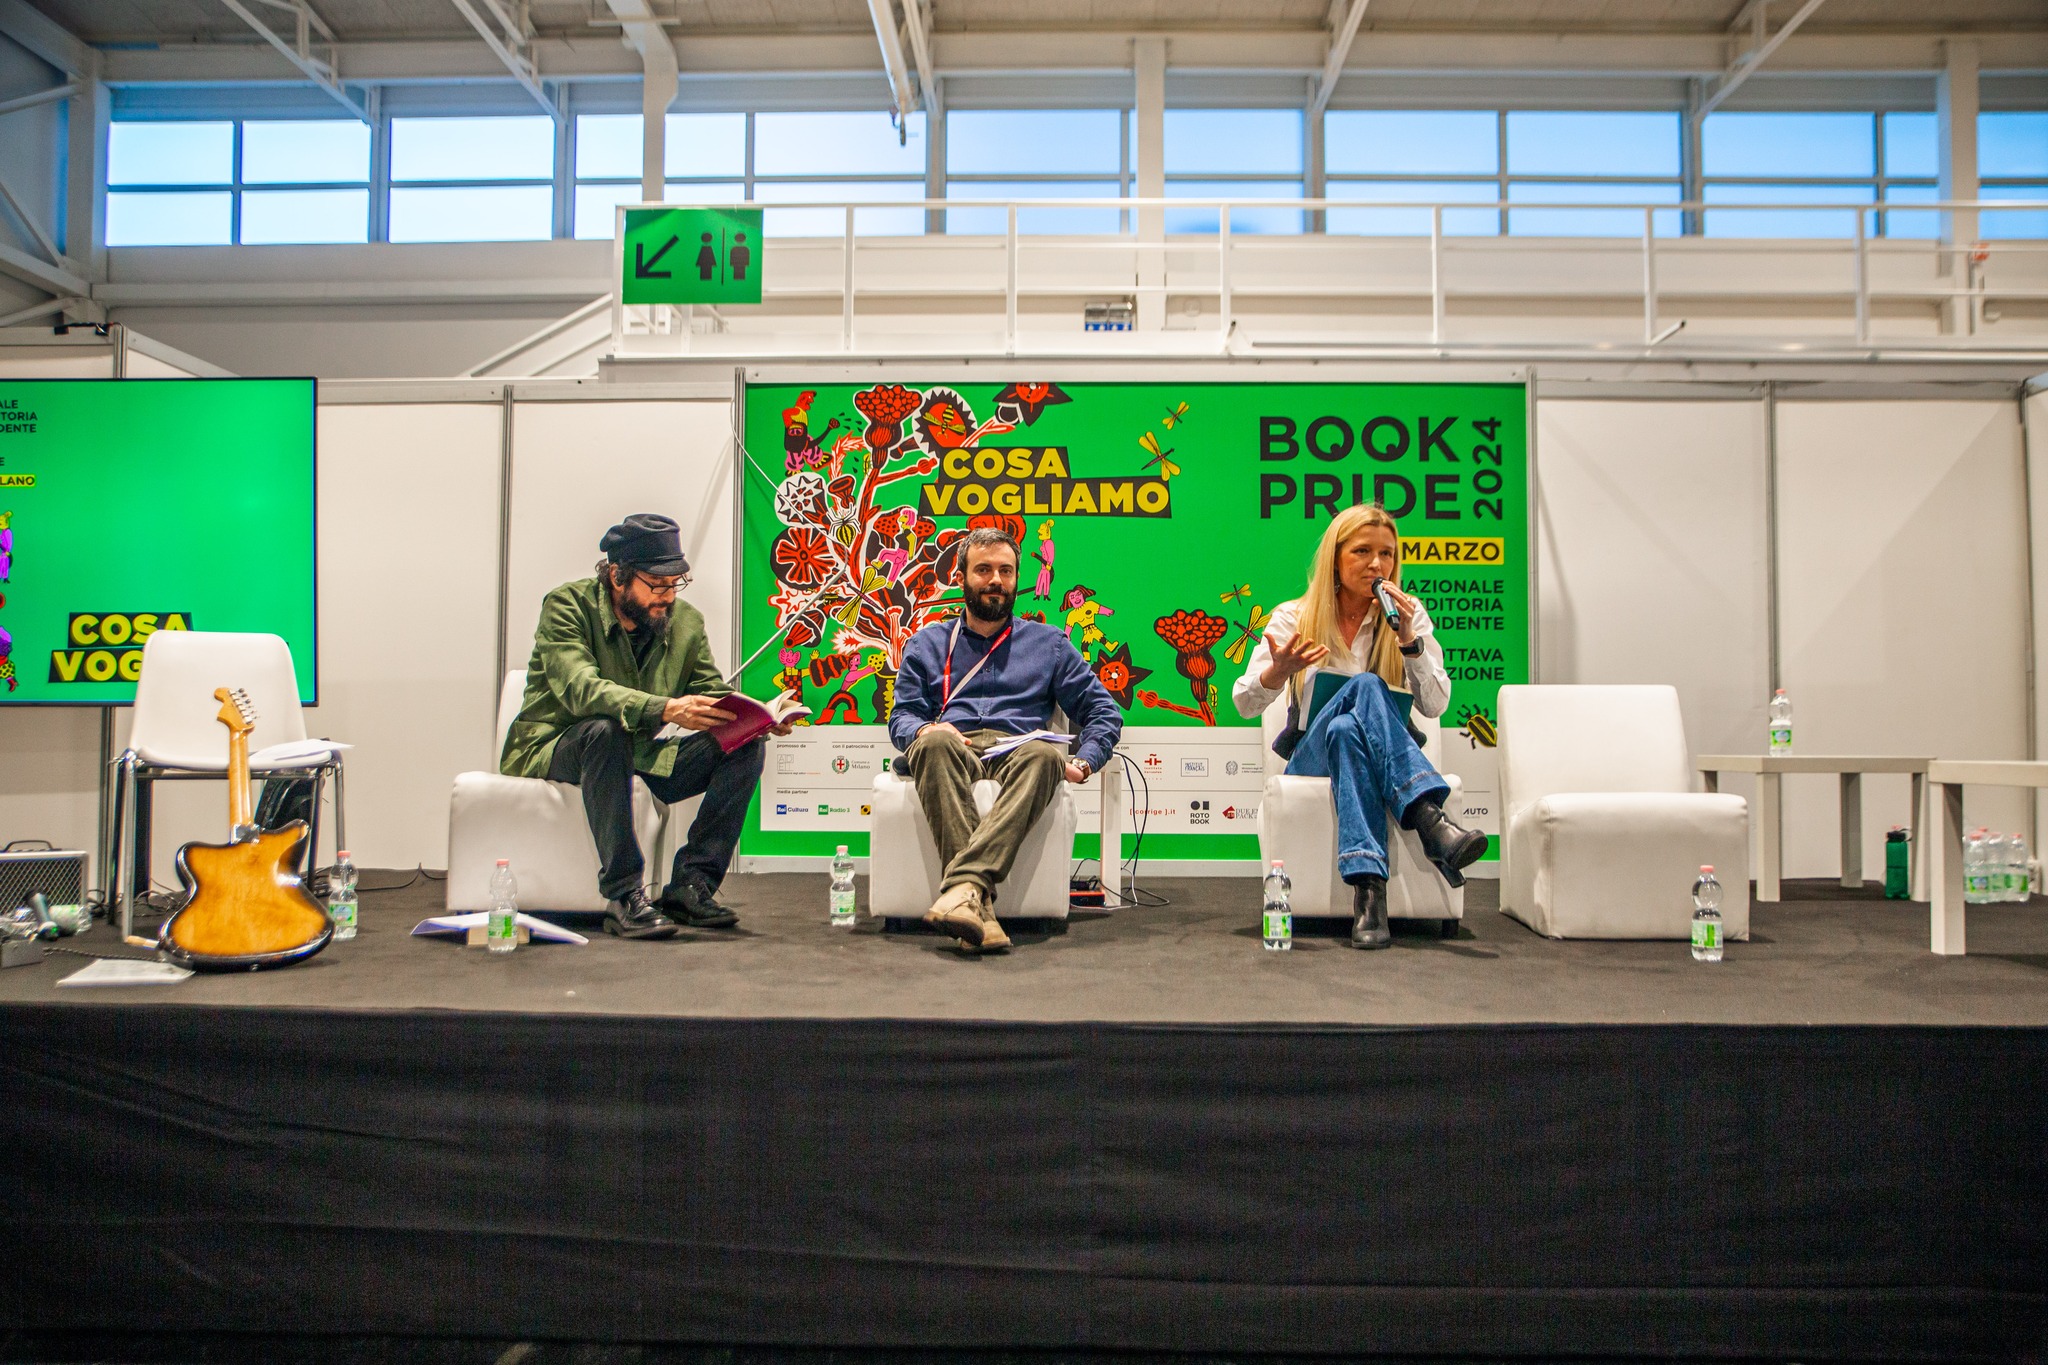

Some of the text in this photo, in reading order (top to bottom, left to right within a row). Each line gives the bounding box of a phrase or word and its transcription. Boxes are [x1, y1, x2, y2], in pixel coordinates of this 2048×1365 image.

[1260, 415, 1460, 463] BOOK
[942, 447, 1068, 479] COSA
[1472, 416, 1503, 521] 2024
[922, 482, 1170, 514] VOGLIAMO
[1260, 473, 1461, 520] PRIDE
[1402, 542, 1500, 561] MARZO
[1419, 597, 1504, 612] DITORIA
[71, 613, 188, 646] COSA
[1443, 648, 1504, 662] TTAVA
